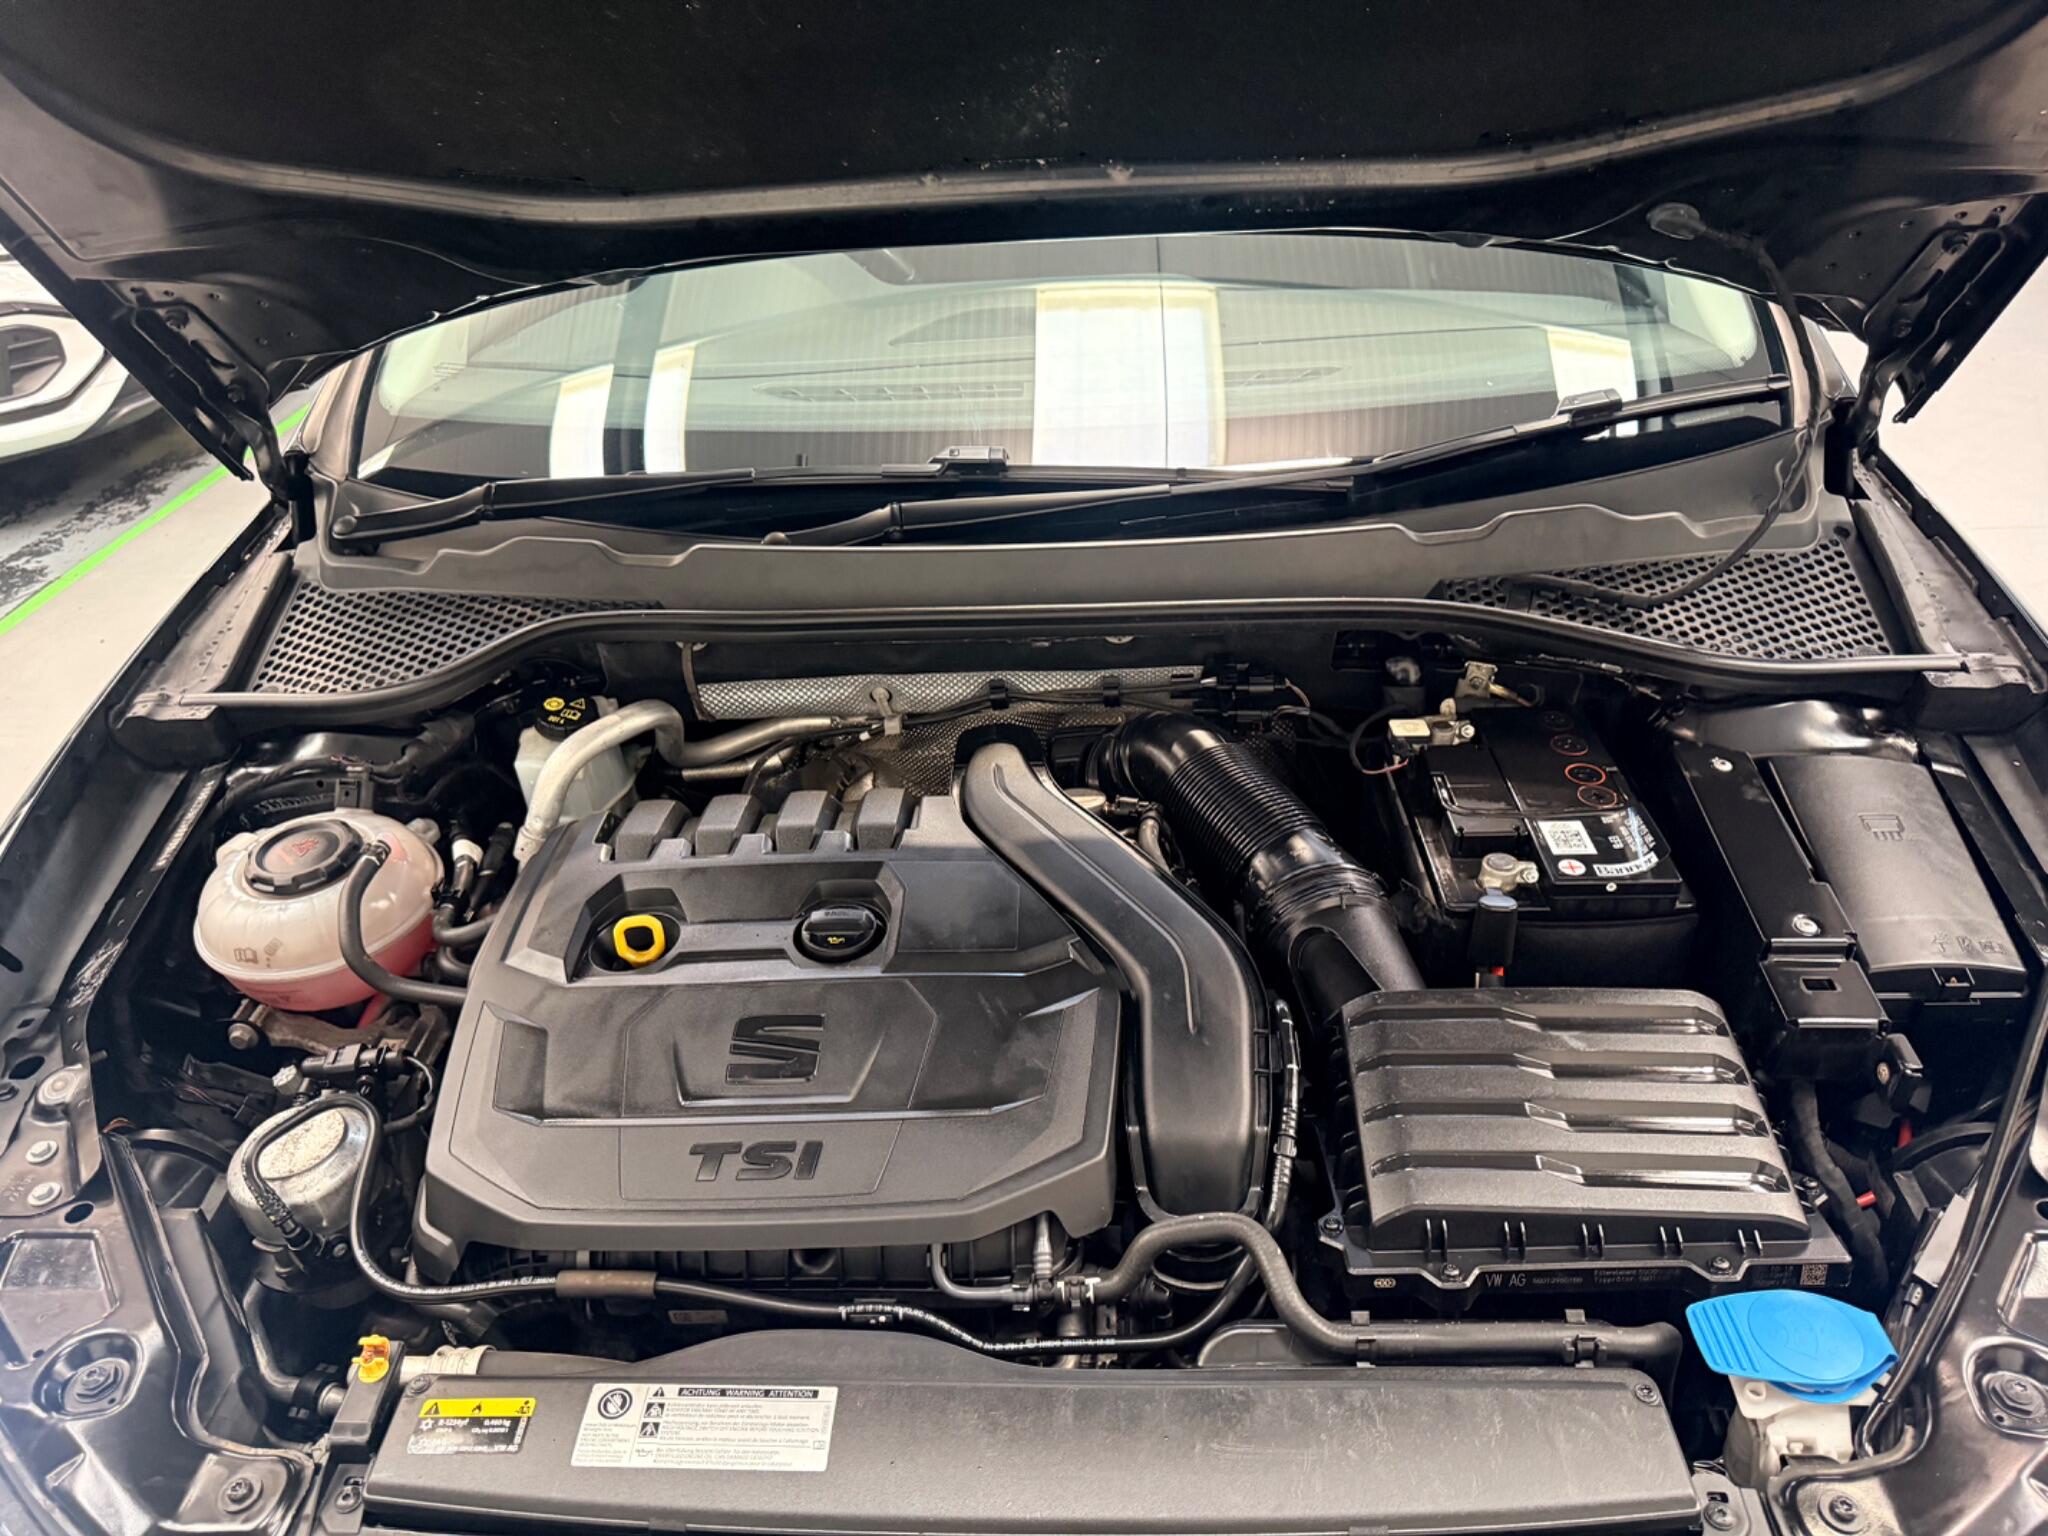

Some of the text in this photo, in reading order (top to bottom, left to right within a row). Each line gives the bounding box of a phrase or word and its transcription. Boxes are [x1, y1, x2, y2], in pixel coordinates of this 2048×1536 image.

[689, 1140, 823, 1182] TSI
[1485, 1273, 1502, 1287] VW
[1509, 1272, 1527, 1287] AG
[680, 1388, 813, 1399] ACHTUNG WARNING ATTENTION
